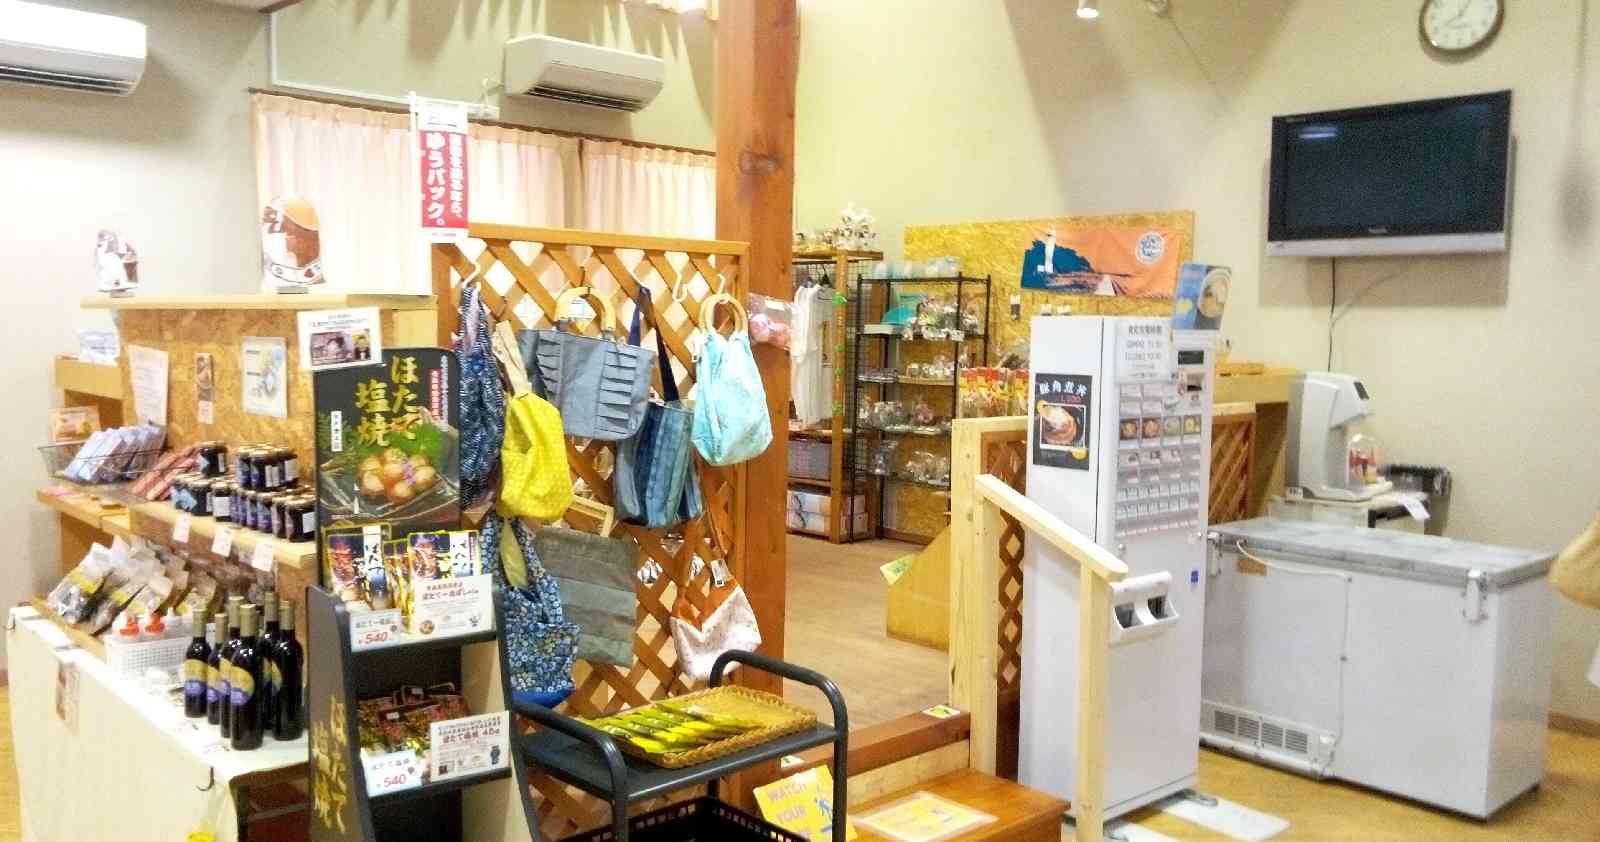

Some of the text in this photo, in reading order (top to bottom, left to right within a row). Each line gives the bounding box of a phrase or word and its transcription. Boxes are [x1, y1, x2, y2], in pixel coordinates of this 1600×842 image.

[426, 132, 446, 227] ゆうパック。
[355, 378, 390, 447] 塩焼
[391, 354, 421, 440] ほたて
